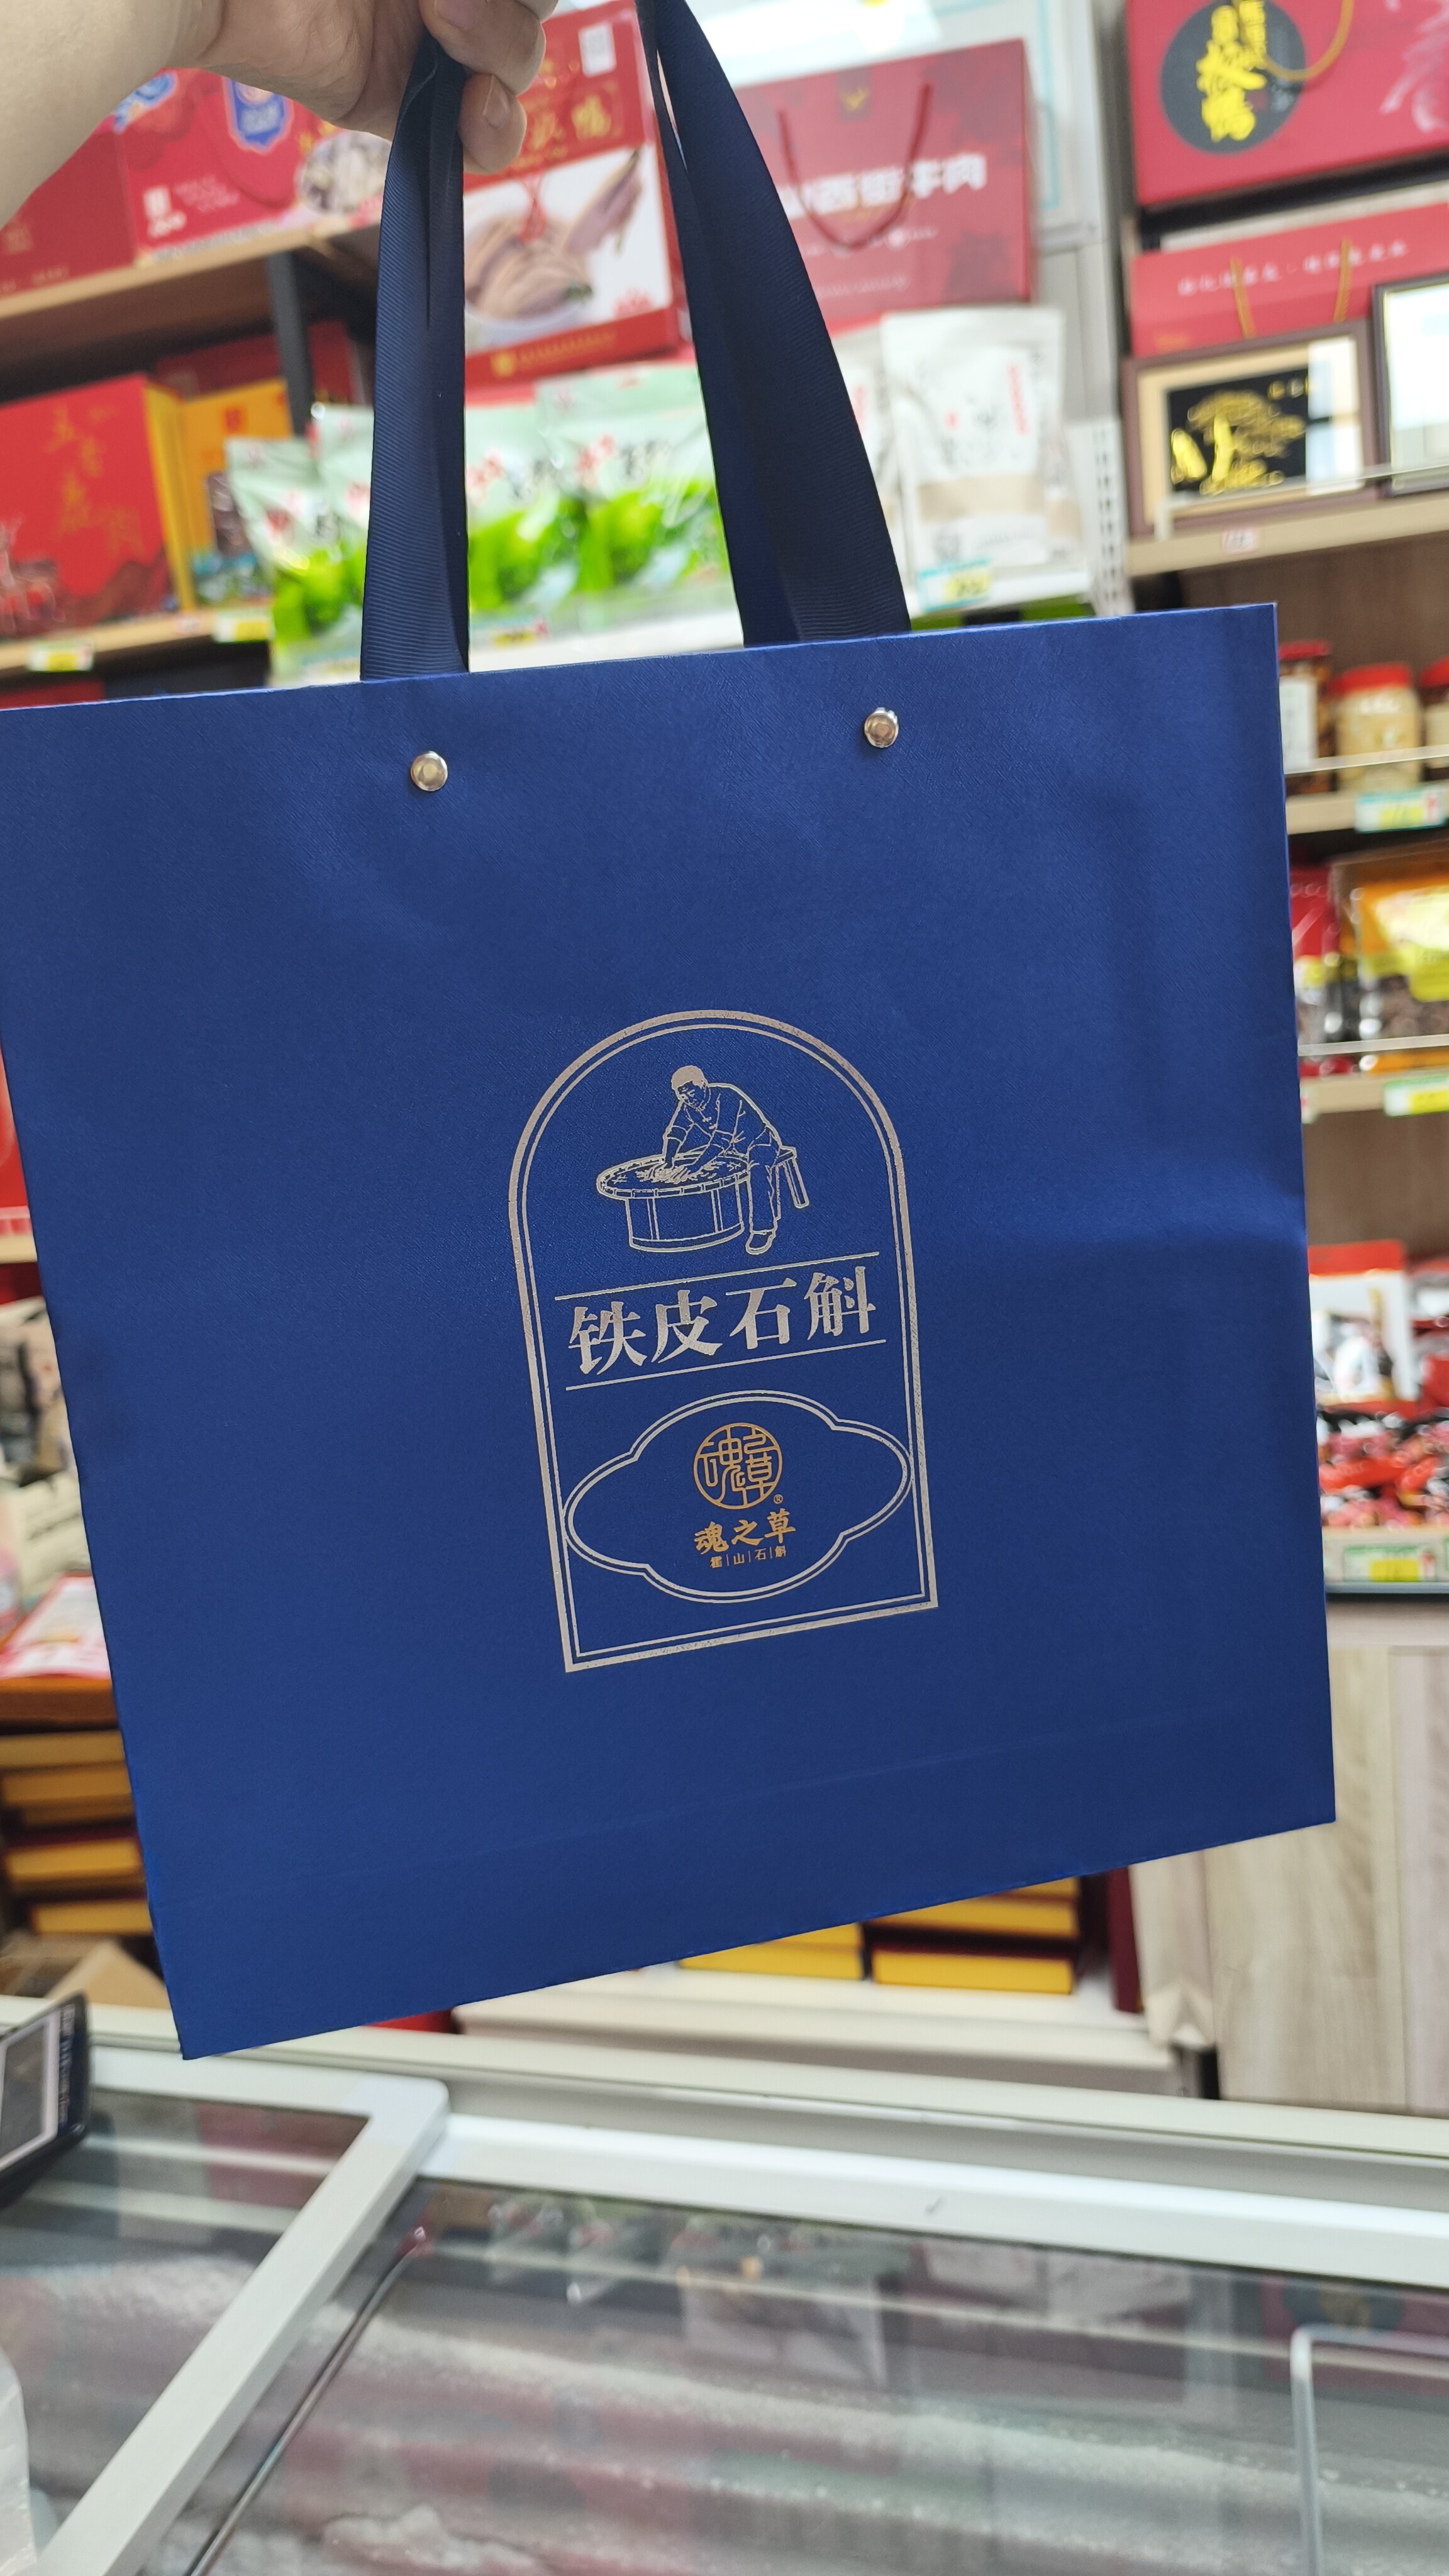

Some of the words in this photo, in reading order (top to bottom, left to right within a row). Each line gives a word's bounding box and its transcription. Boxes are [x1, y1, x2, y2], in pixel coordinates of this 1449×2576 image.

[568, 1266, 876, 1375] 铁皮石斛
[694, 1507, 796, 1555] 魂之草
